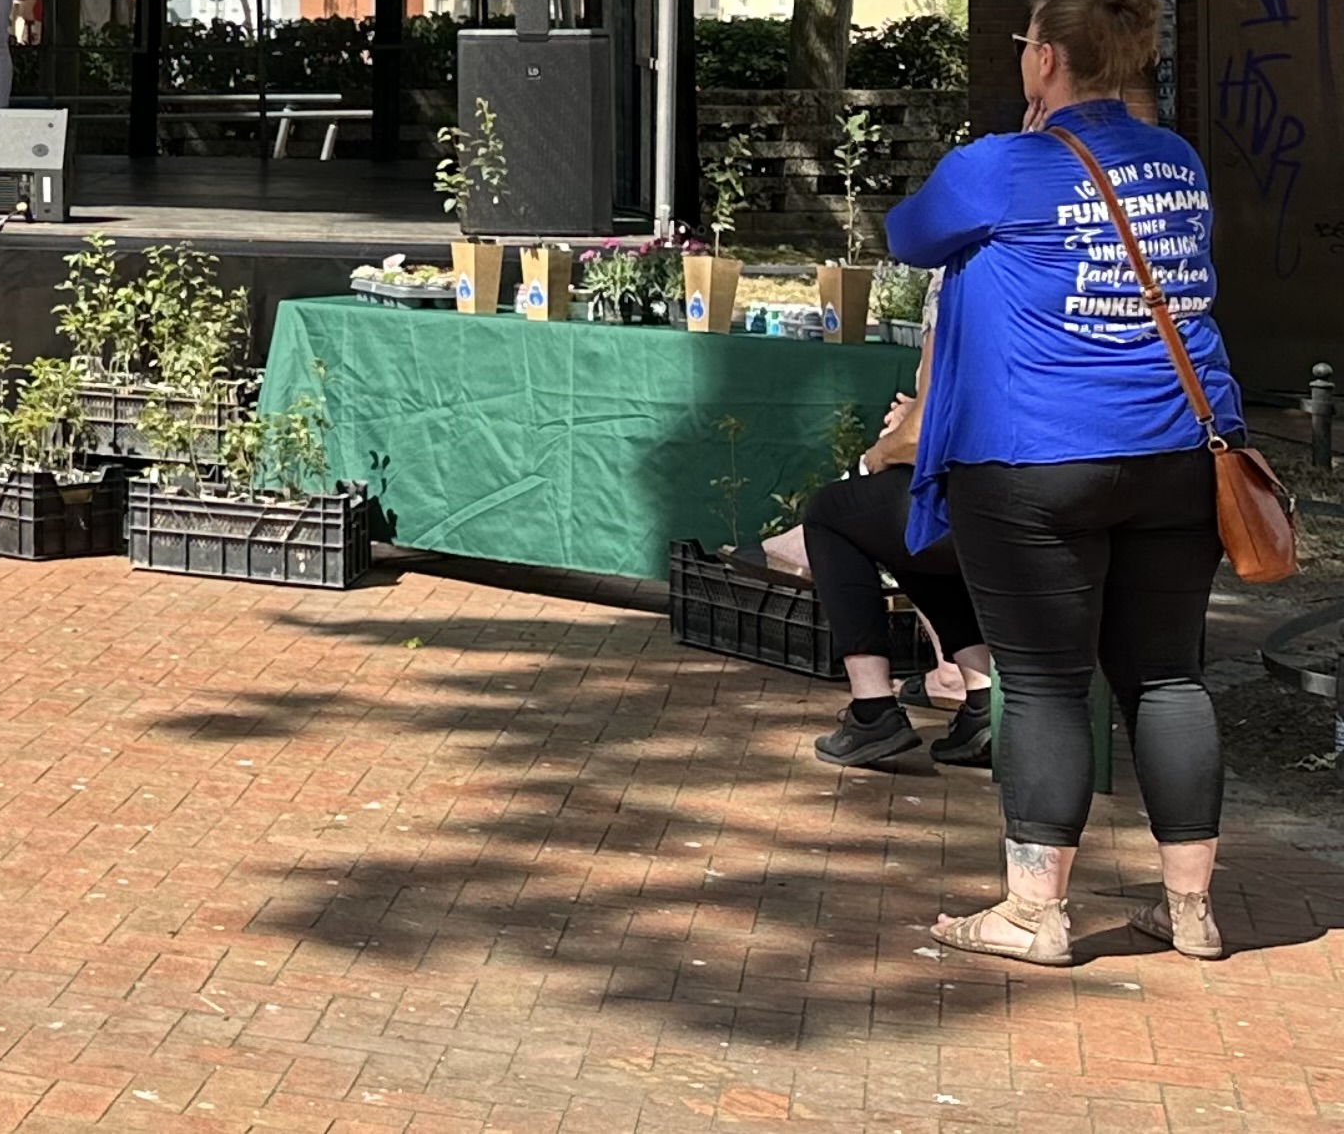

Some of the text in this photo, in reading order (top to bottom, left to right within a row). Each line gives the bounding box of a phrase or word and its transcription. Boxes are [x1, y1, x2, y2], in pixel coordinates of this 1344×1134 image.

[1074, 161, 1196, 200] IC BIN STOLZE
[1056, 190, 1210, 226] FUNENMAMA
[1130, 218, 1167, 237] EINER
